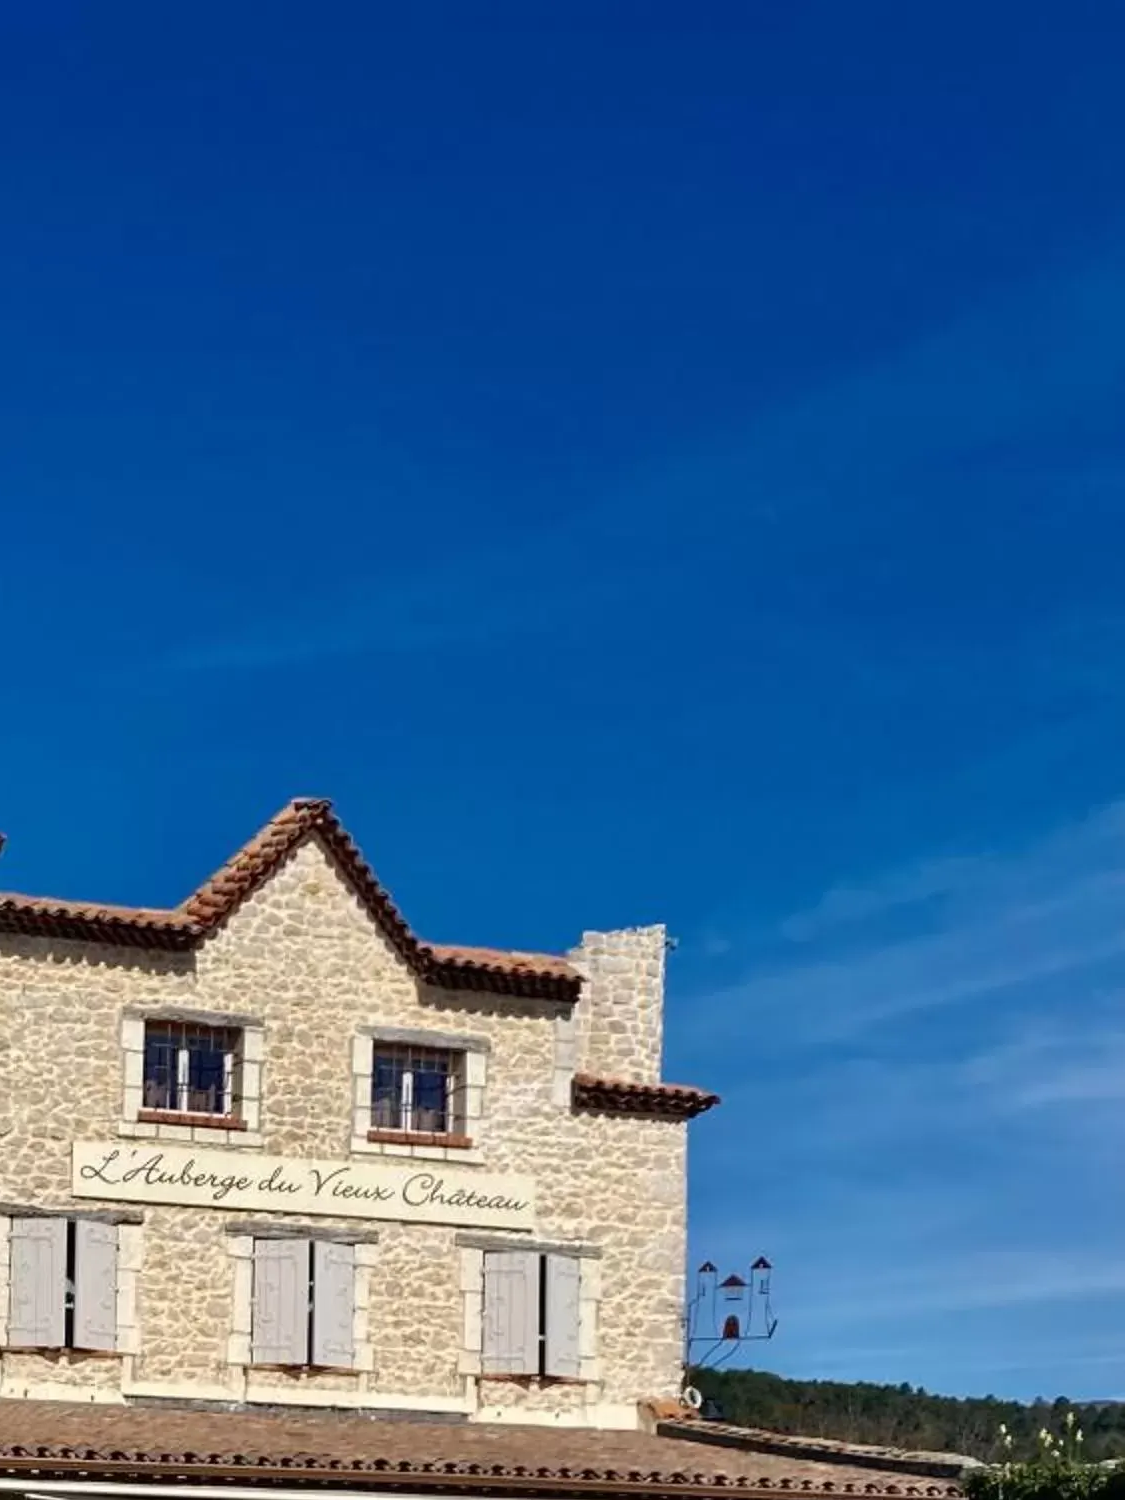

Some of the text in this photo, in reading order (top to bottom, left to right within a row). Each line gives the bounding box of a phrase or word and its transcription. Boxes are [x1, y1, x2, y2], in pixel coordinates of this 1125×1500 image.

[80, 1149, 529, 1212] L'Auberge du Vieux Château
